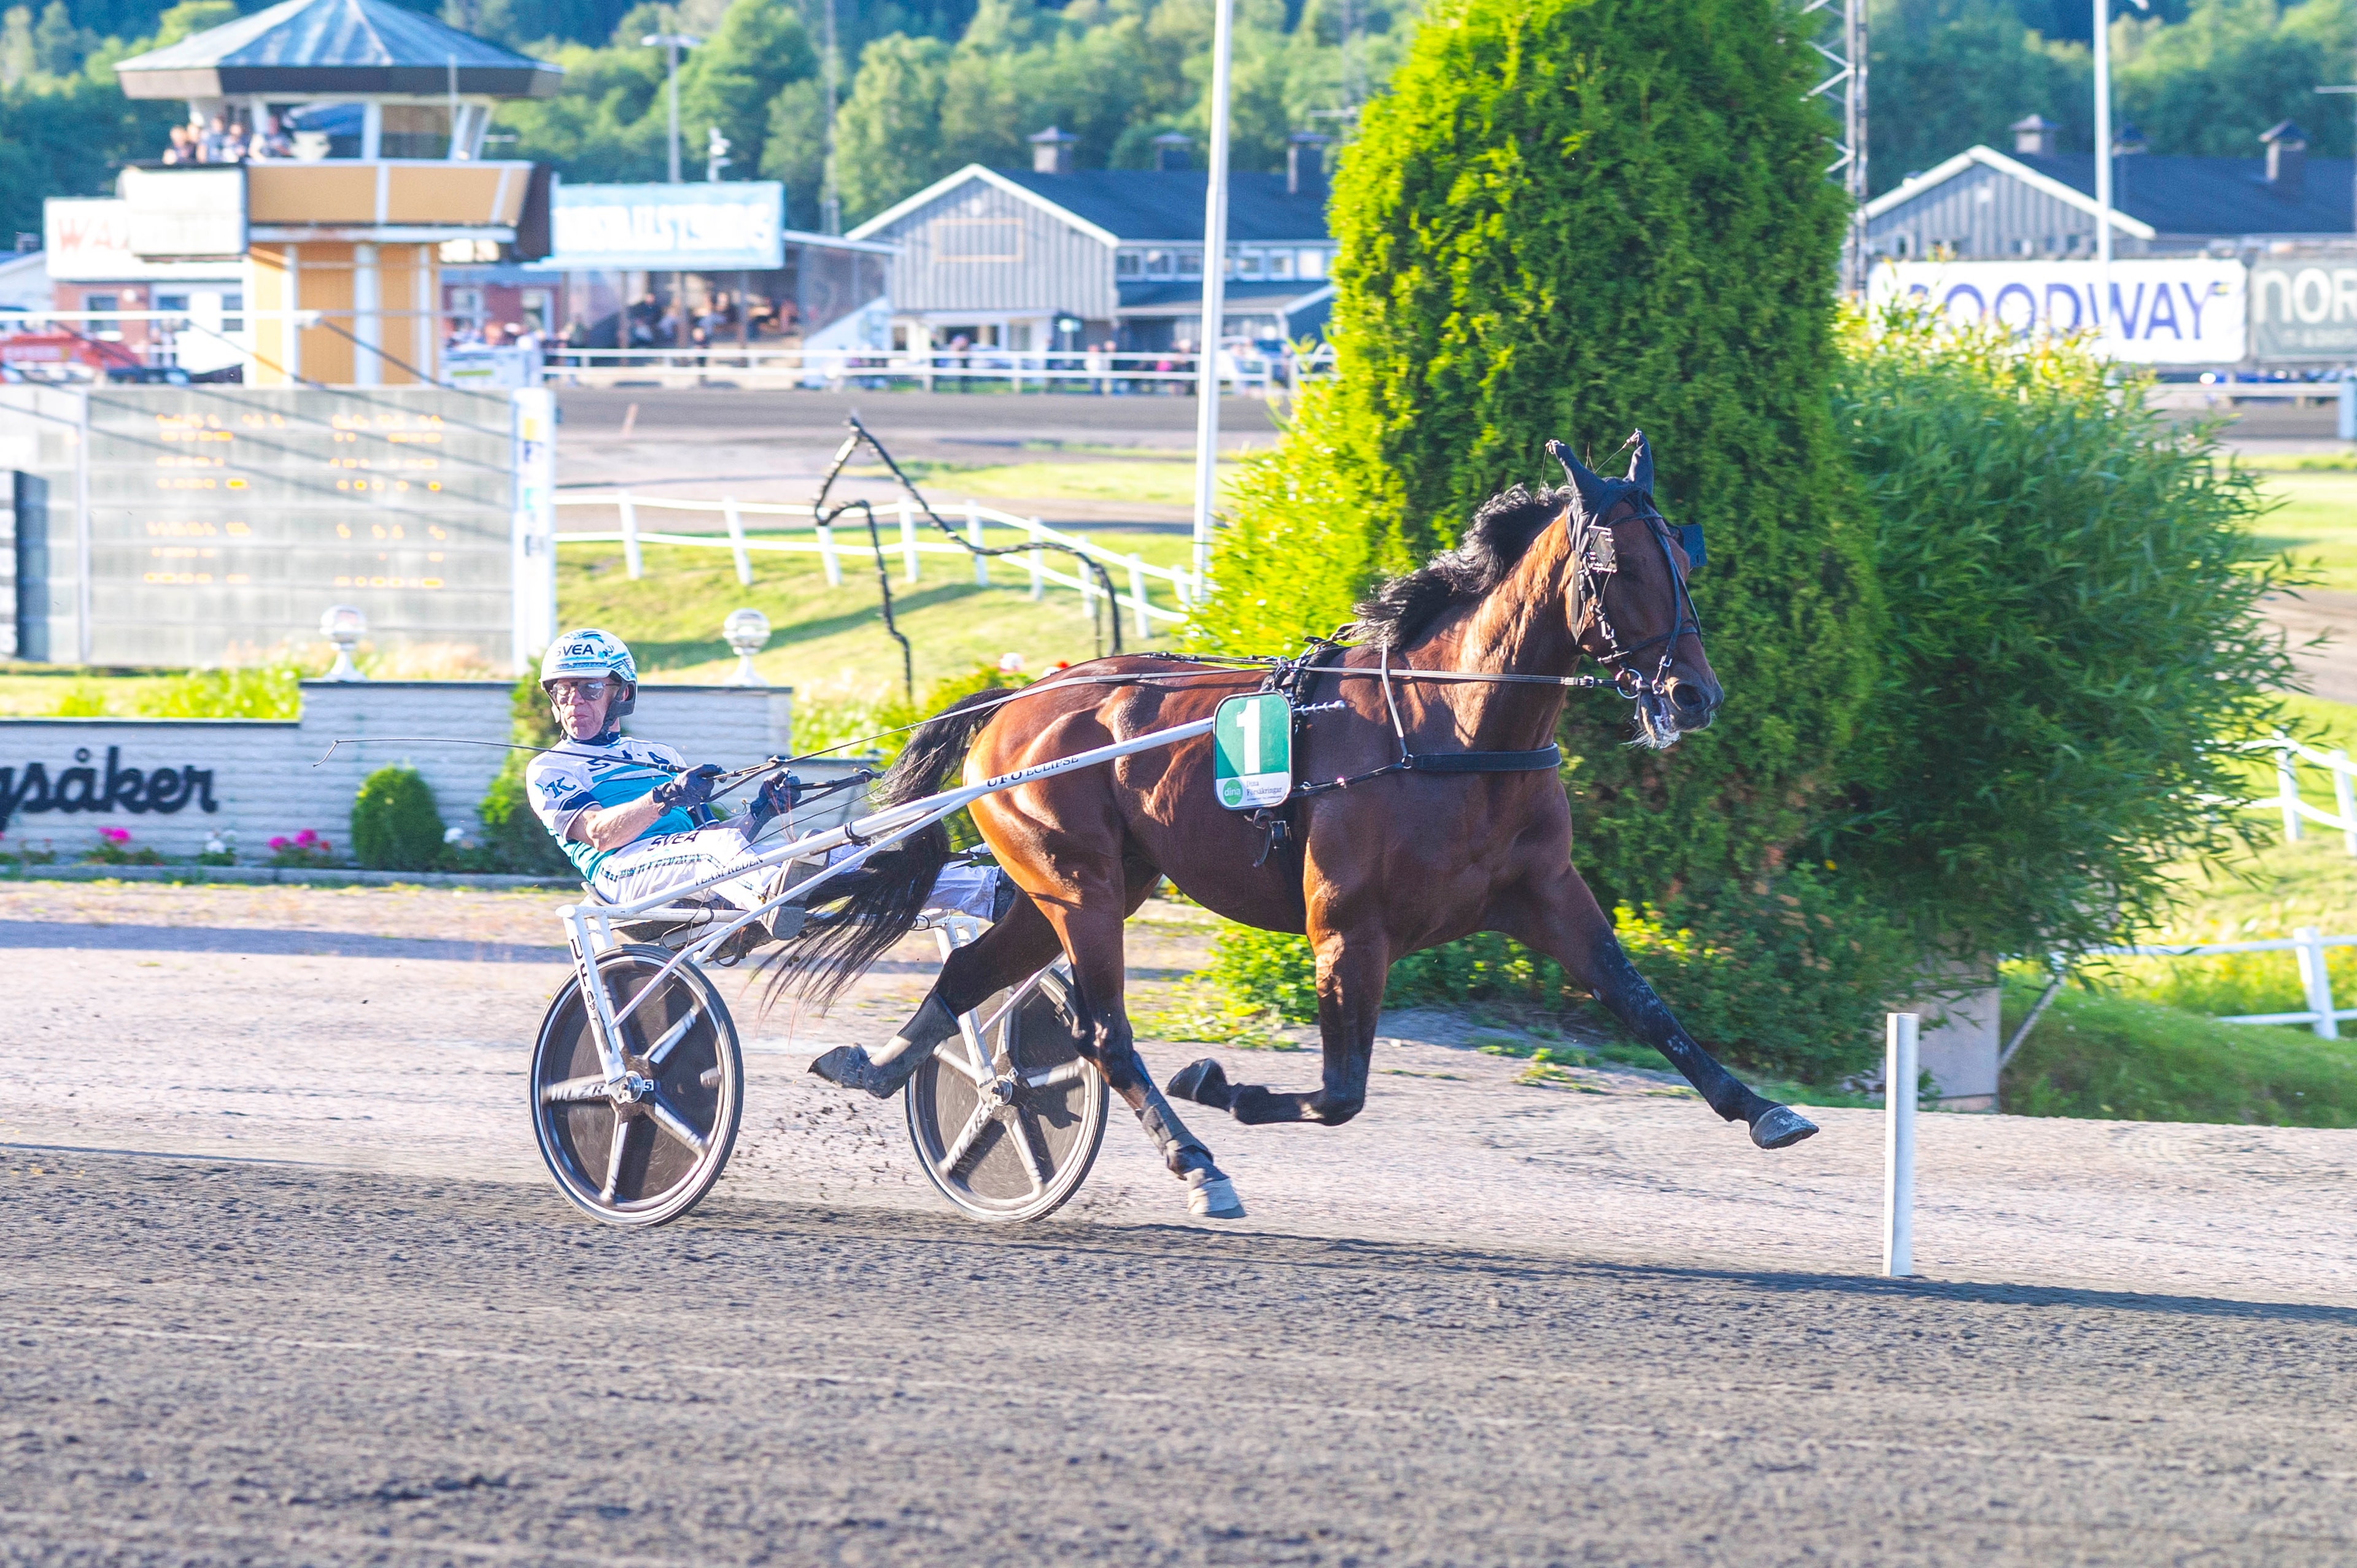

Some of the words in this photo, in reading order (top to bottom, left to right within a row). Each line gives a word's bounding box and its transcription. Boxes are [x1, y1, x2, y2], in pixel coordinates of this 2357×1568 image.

[1905, 282, 2212, 340] OODWAY
[555, 644, 594, 657] SVEA
[1236, 698, 1261, 775] 1
[1224, 787, 1241, 797] dina
[646, 830, 701, 851] SVEA
[644, 1081, 652, 1091] 5
